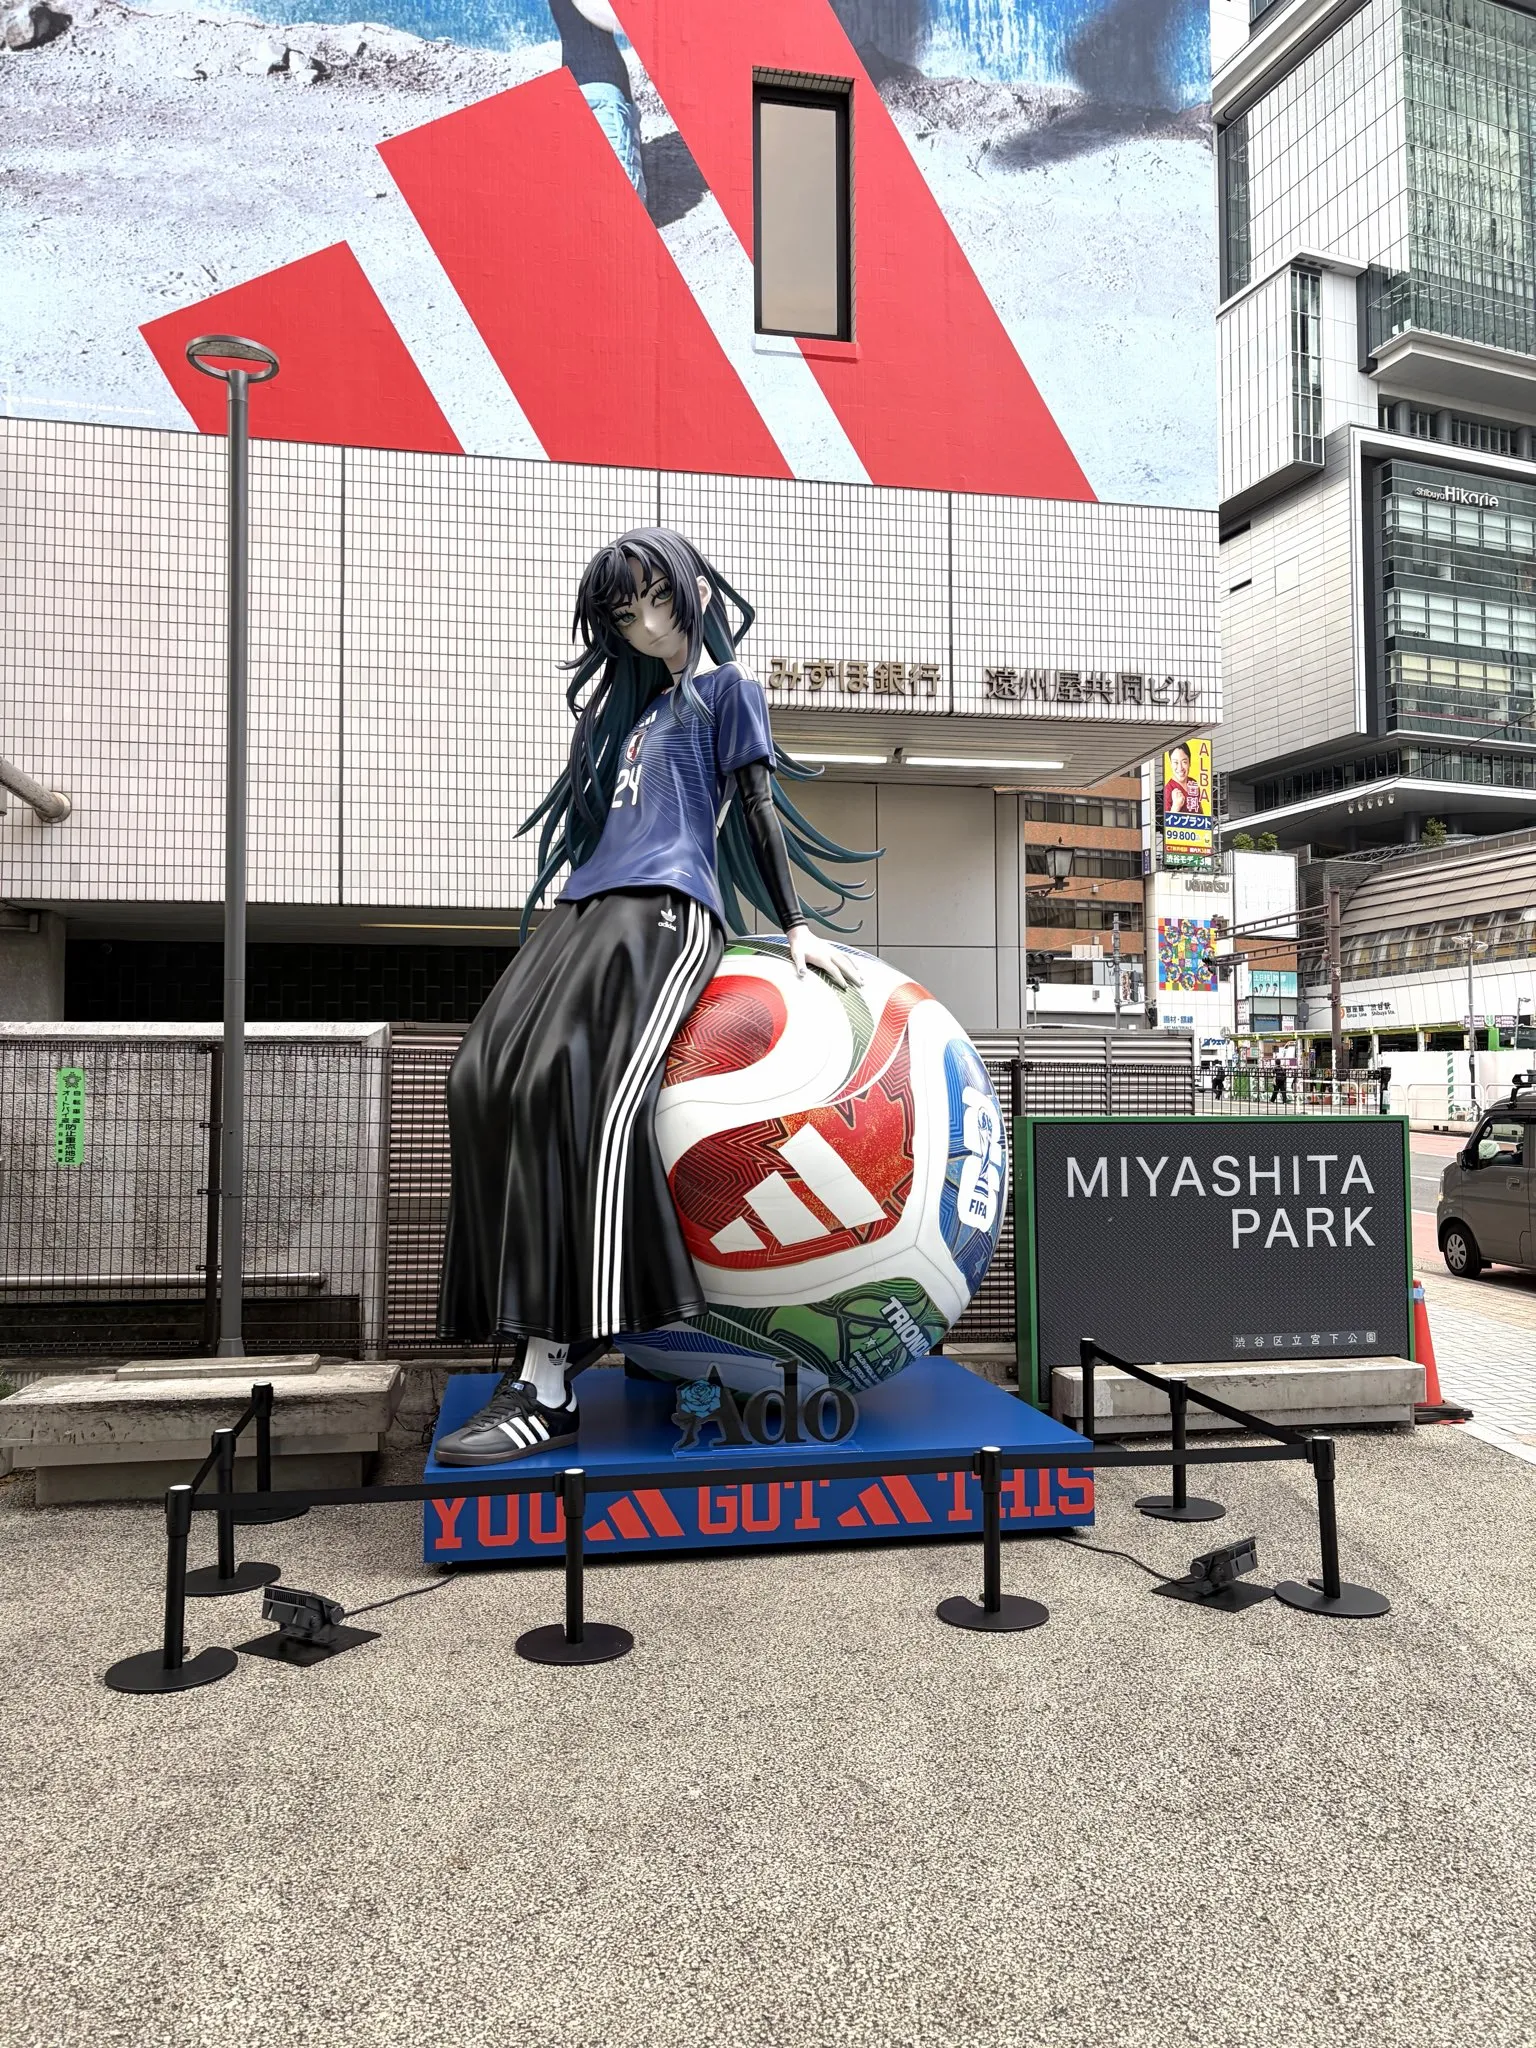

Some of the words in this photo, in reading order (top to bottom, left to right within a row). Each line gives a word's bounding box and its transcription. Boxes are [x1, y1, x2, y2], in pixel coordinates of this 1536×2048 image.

[1415, 487, 1446, 501] Shibuya
[1445, 486, 1499, 508] Hikarie
[769, 658, 941, 697] みずほ銀行
[985, 667, 1201, 705] 遠州屋共同ビル
[611, 764, 642, 809] 24
[1199, 743, 1210, 803] ALBA
[1187, 781, 1199, 812] 歯科
[1166, 815, 1211, 829] インプラント
[65, 1124, 76, 1162] 防止重点地区
[1066, 1154, 1375, 1198] MIYASHITA
[968, 1198, 988, 1220] FIFA
[1231, 1206, 1376, 1250] PARK
[1235, 1331, 1377, 1348] 渋谷区立宮下公園
[674, 1360, 856, 1449] Ado
[697, 1479, 831, 1535] GOT
